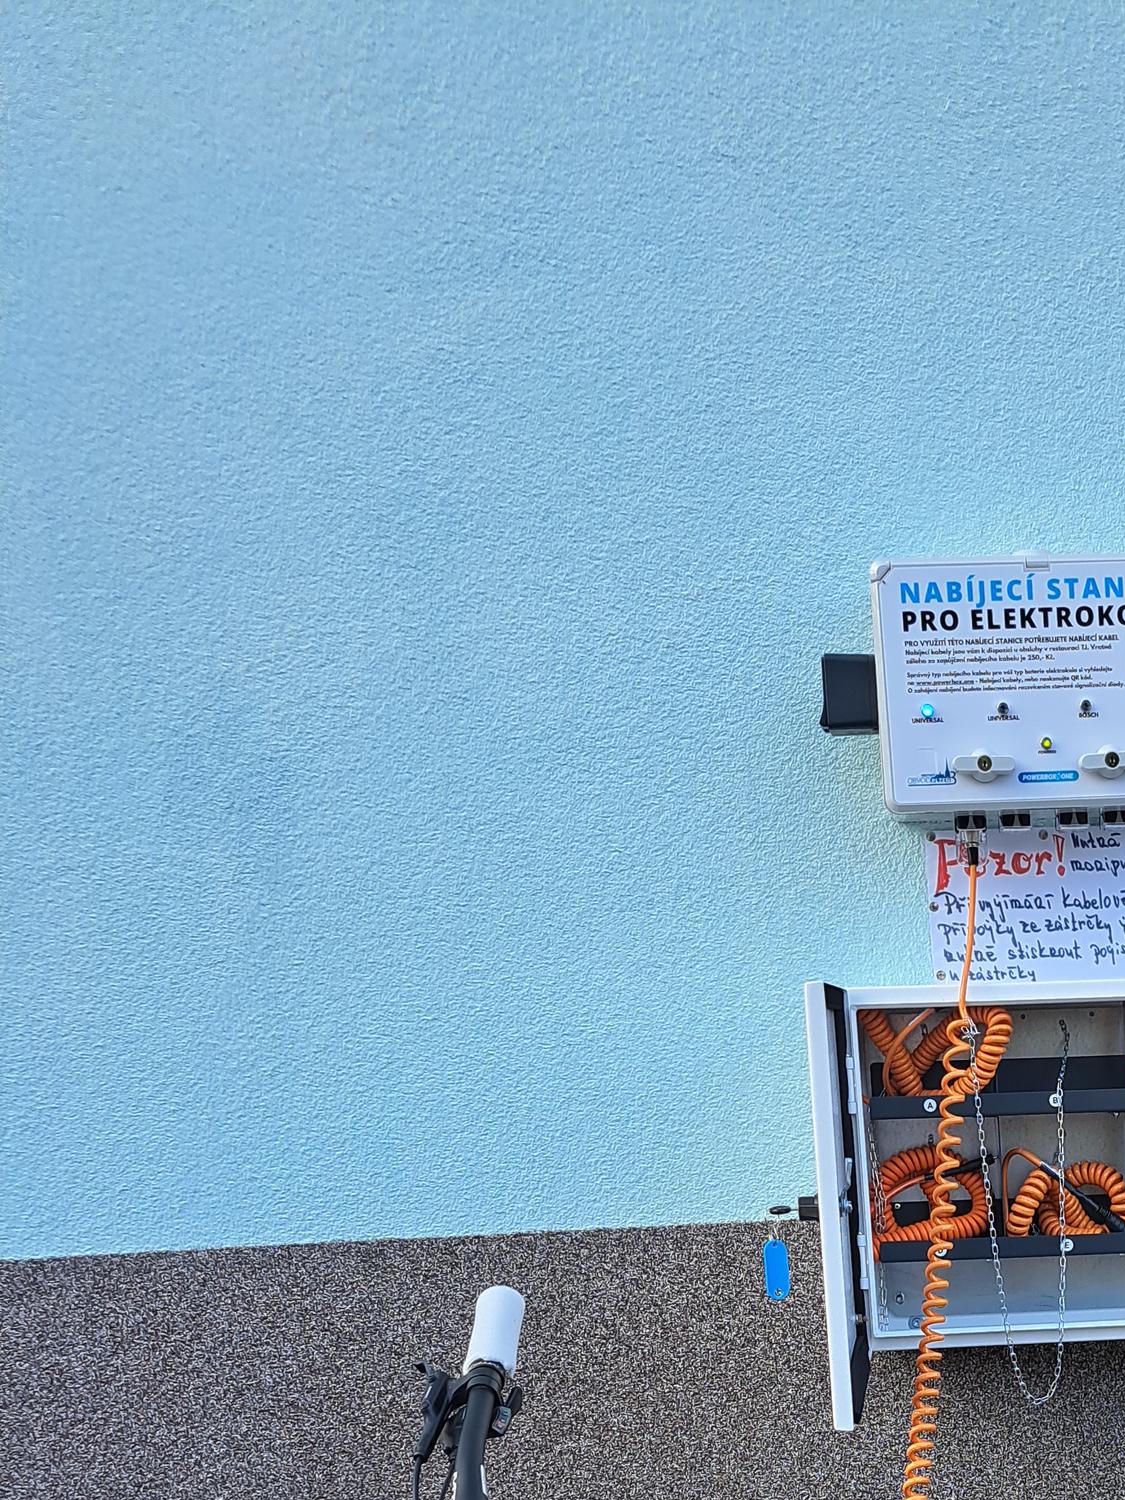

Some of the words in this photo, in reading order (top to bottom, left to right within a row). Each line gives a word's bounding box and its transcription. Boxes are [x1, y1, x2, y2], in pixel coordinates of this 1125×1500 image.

[900, 573, 1035, 608] NABÍJECÍ
[901, 609, 960, 633] PRO
[920, 638, 946, 646] VYUŽITÍ
[948, 637, 964, 646] TÉTO
[966, 636, 994, 645] NABÍJECÍ
[1024, 635, 1068, 644] POTŘEBUJETE
[1069, 634, 1098, 642] NABÍJECÍ
[937, 918, 1017, 948] příojky
[1020, 918, 1042, 933] ze
